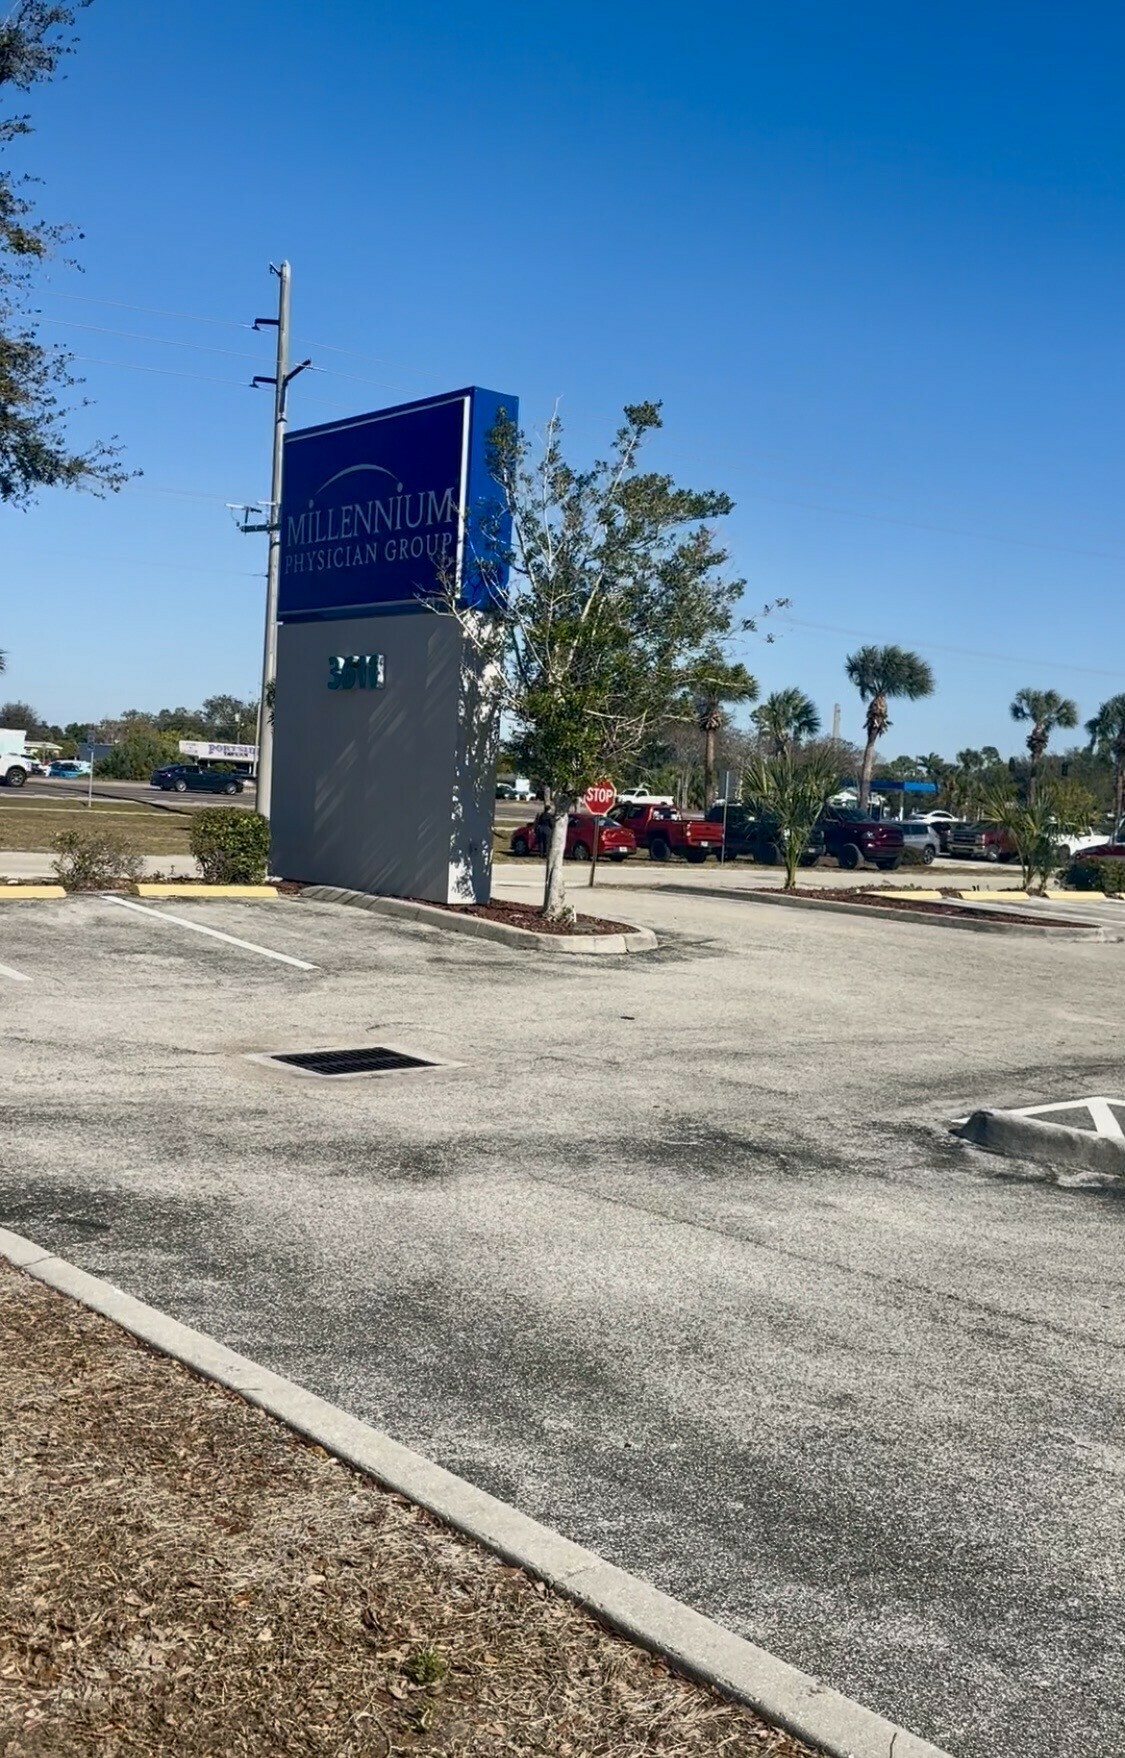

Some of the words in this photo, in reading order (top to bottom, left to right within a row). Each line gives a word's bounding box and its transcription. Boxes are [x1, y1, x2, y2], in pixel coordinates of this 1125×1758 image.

[285, 543, 378, 574] PHYSICIAN
[384, 532, 452, 562] GROUP
[208, 744, 256, 755] PORTSID
[586, 787, 613, 803] STOP
